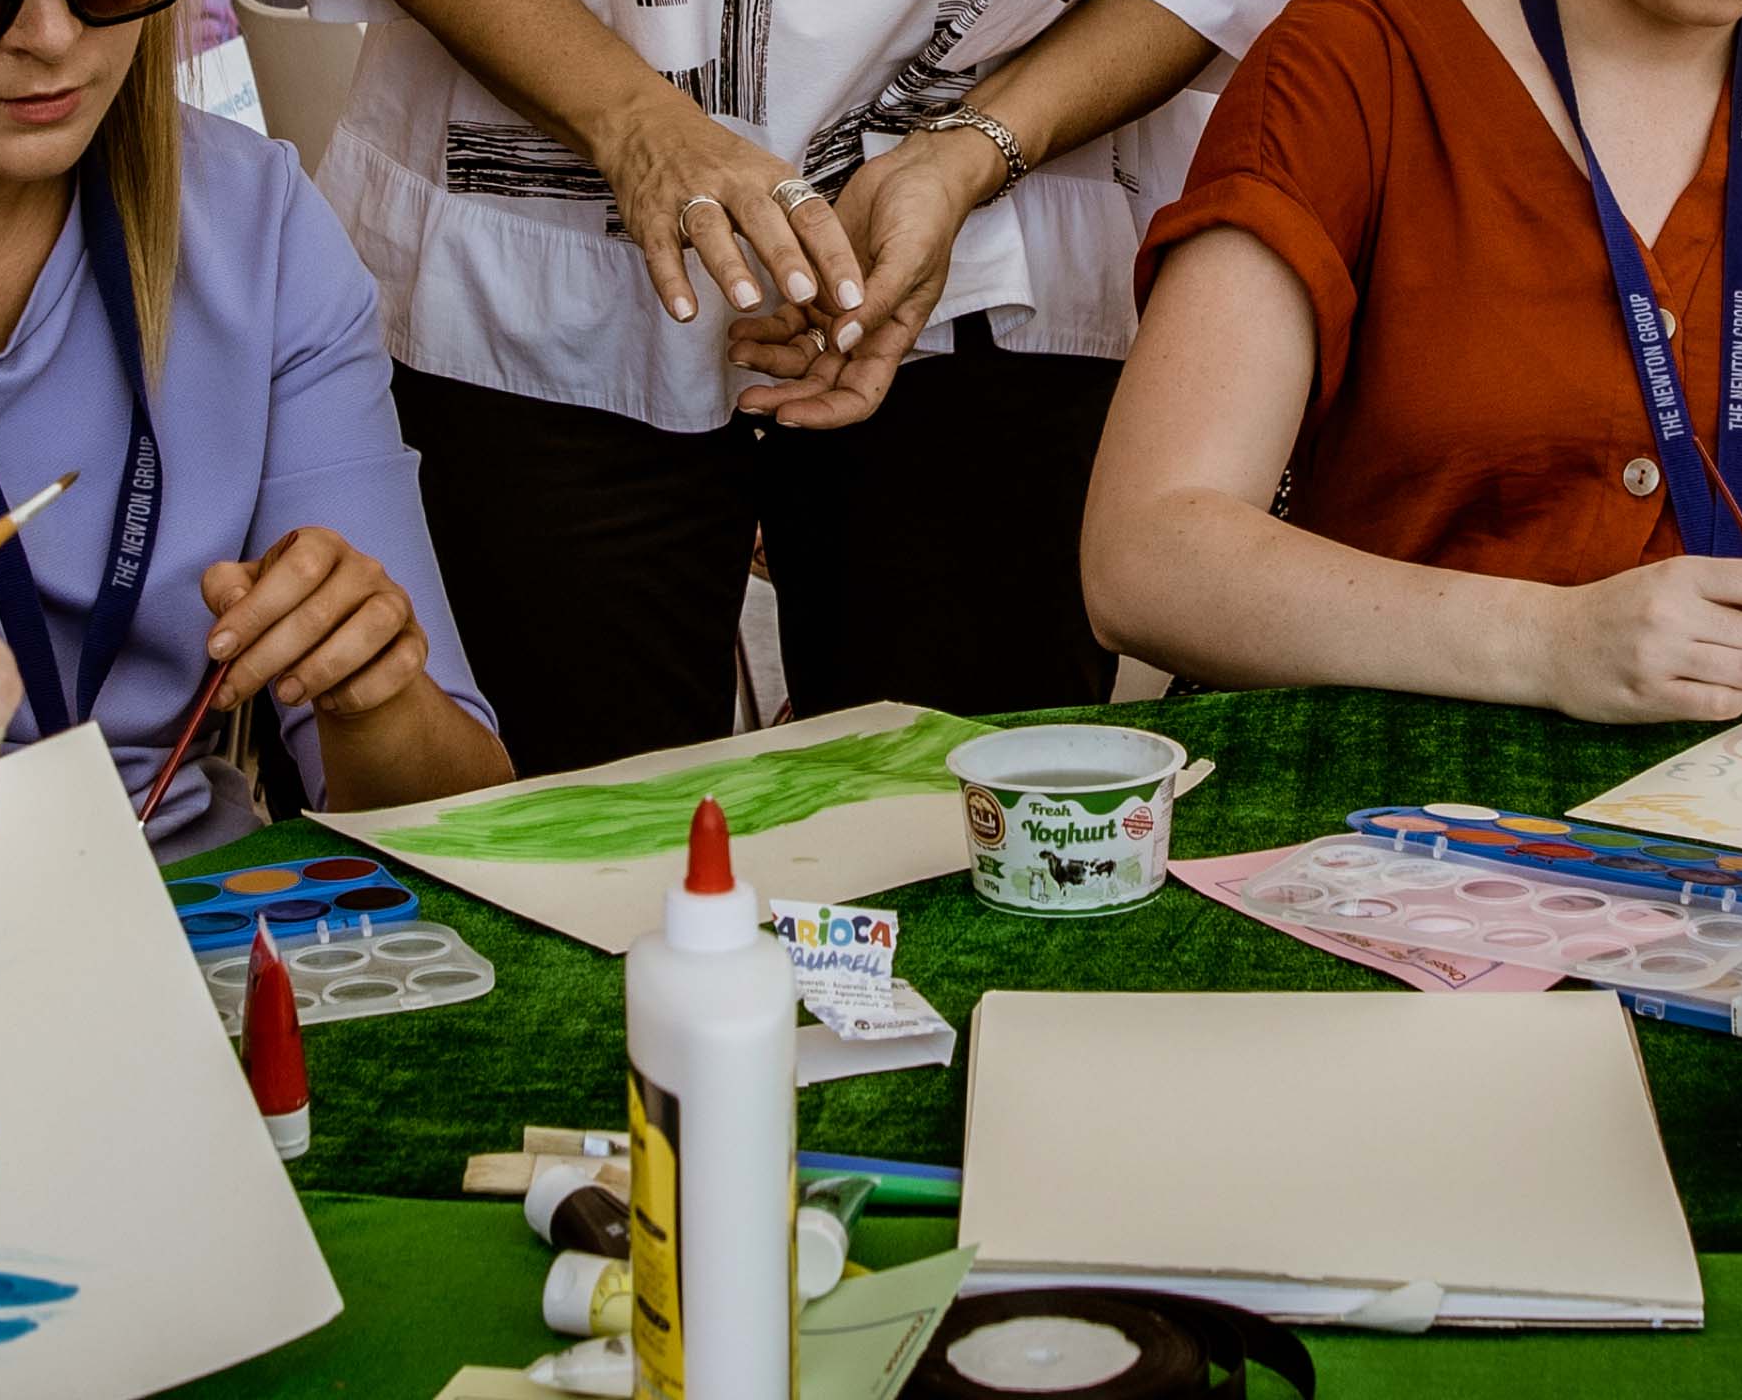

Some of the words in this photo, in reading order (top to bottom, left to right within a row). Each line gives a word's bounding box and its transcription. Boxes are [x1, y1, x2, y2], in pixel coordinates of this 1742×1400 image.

[1629, 293, 1660, 343] GROUP
[1642, 344, 1677, 408] NEWTON
[1659, 408, 1685, 441] THE
[132, 435, 156, 490] GROUP
[120, 492, 153, 558] NEWTON
[111, 556, 140, 589] THE
[1028, 801, 1072, 817] Fresh
[1021, 818, 1118, 850] Yoghurt
[786, 946, 886, 977] QUARELL
